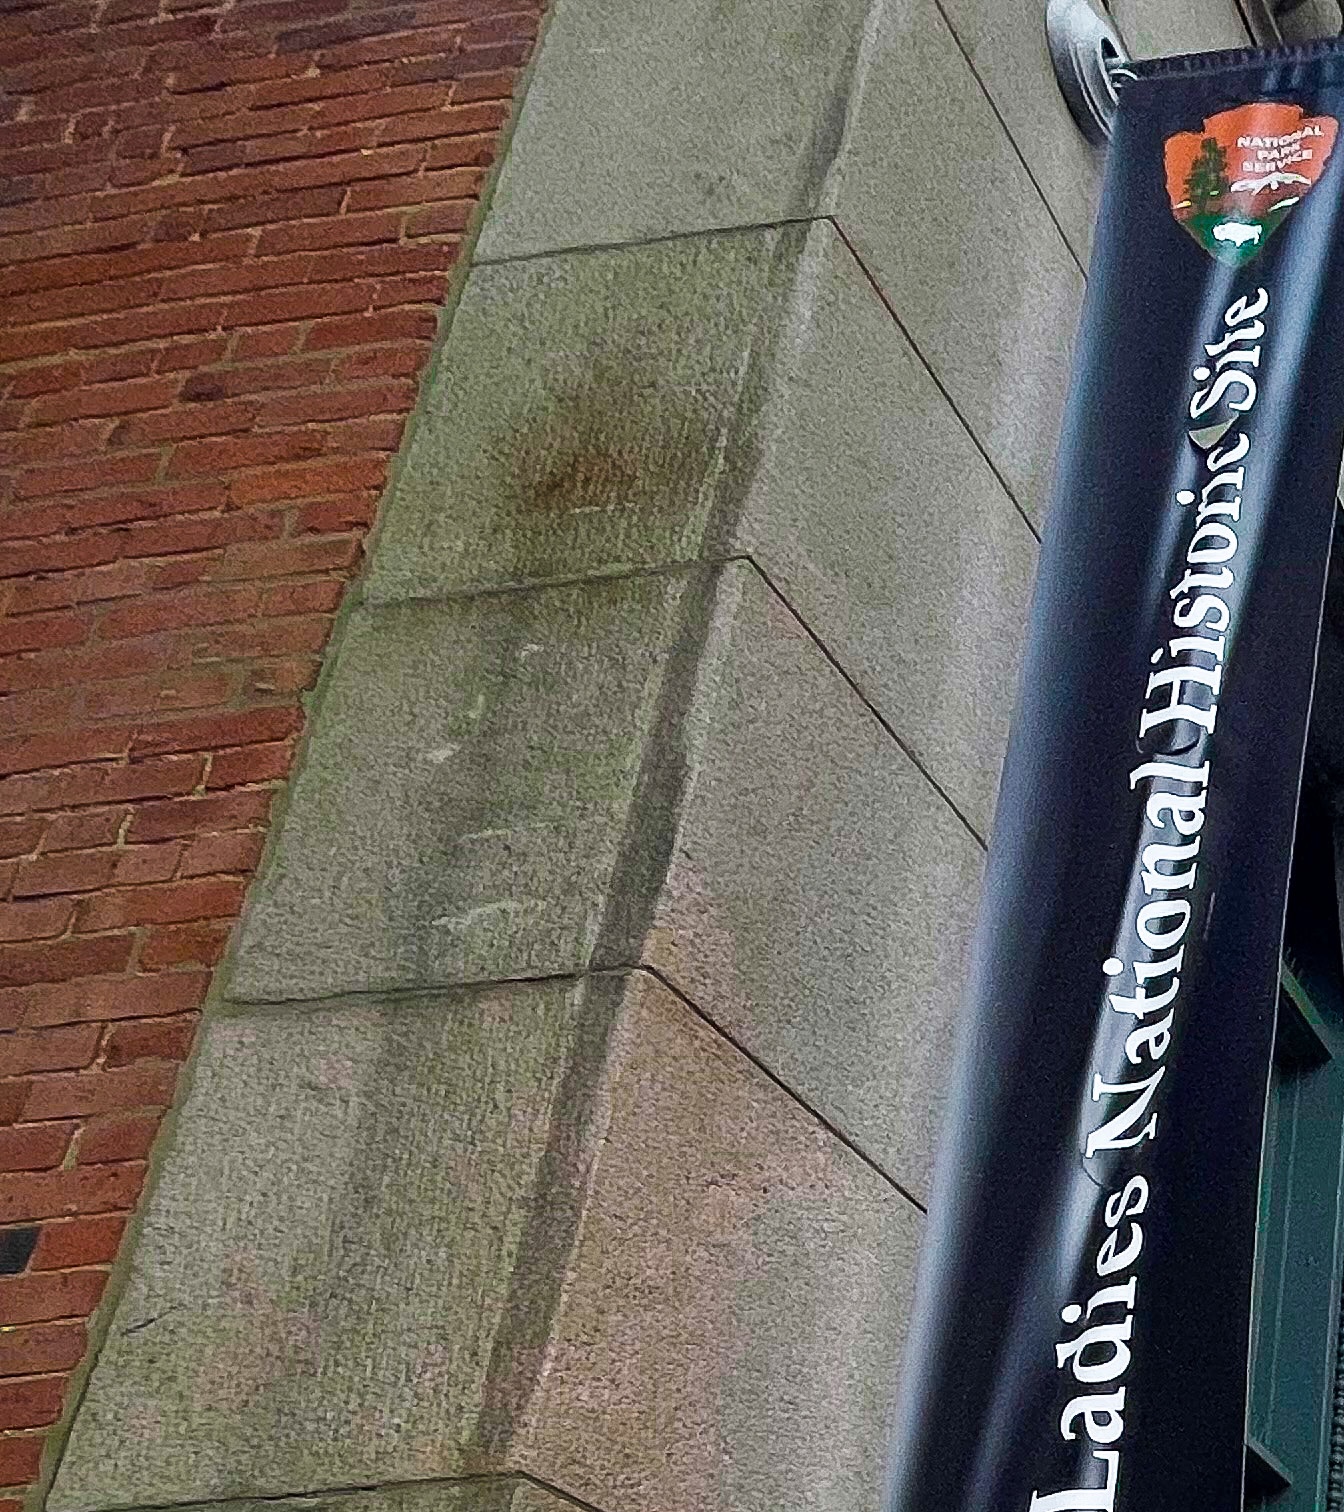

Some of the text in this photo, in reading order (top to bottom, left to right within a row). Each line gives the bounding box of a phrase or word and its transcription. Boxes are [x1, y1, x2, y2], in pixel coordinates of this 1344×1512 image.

[1236, 124, 1324, 149] NATIONAL
[1256, 144, 1302, 162] PARK
[1189, 287, 1269, 419] Site
[1138, 432, 1252, 738] Historic
[1084, 760, 1214, 1158] National
